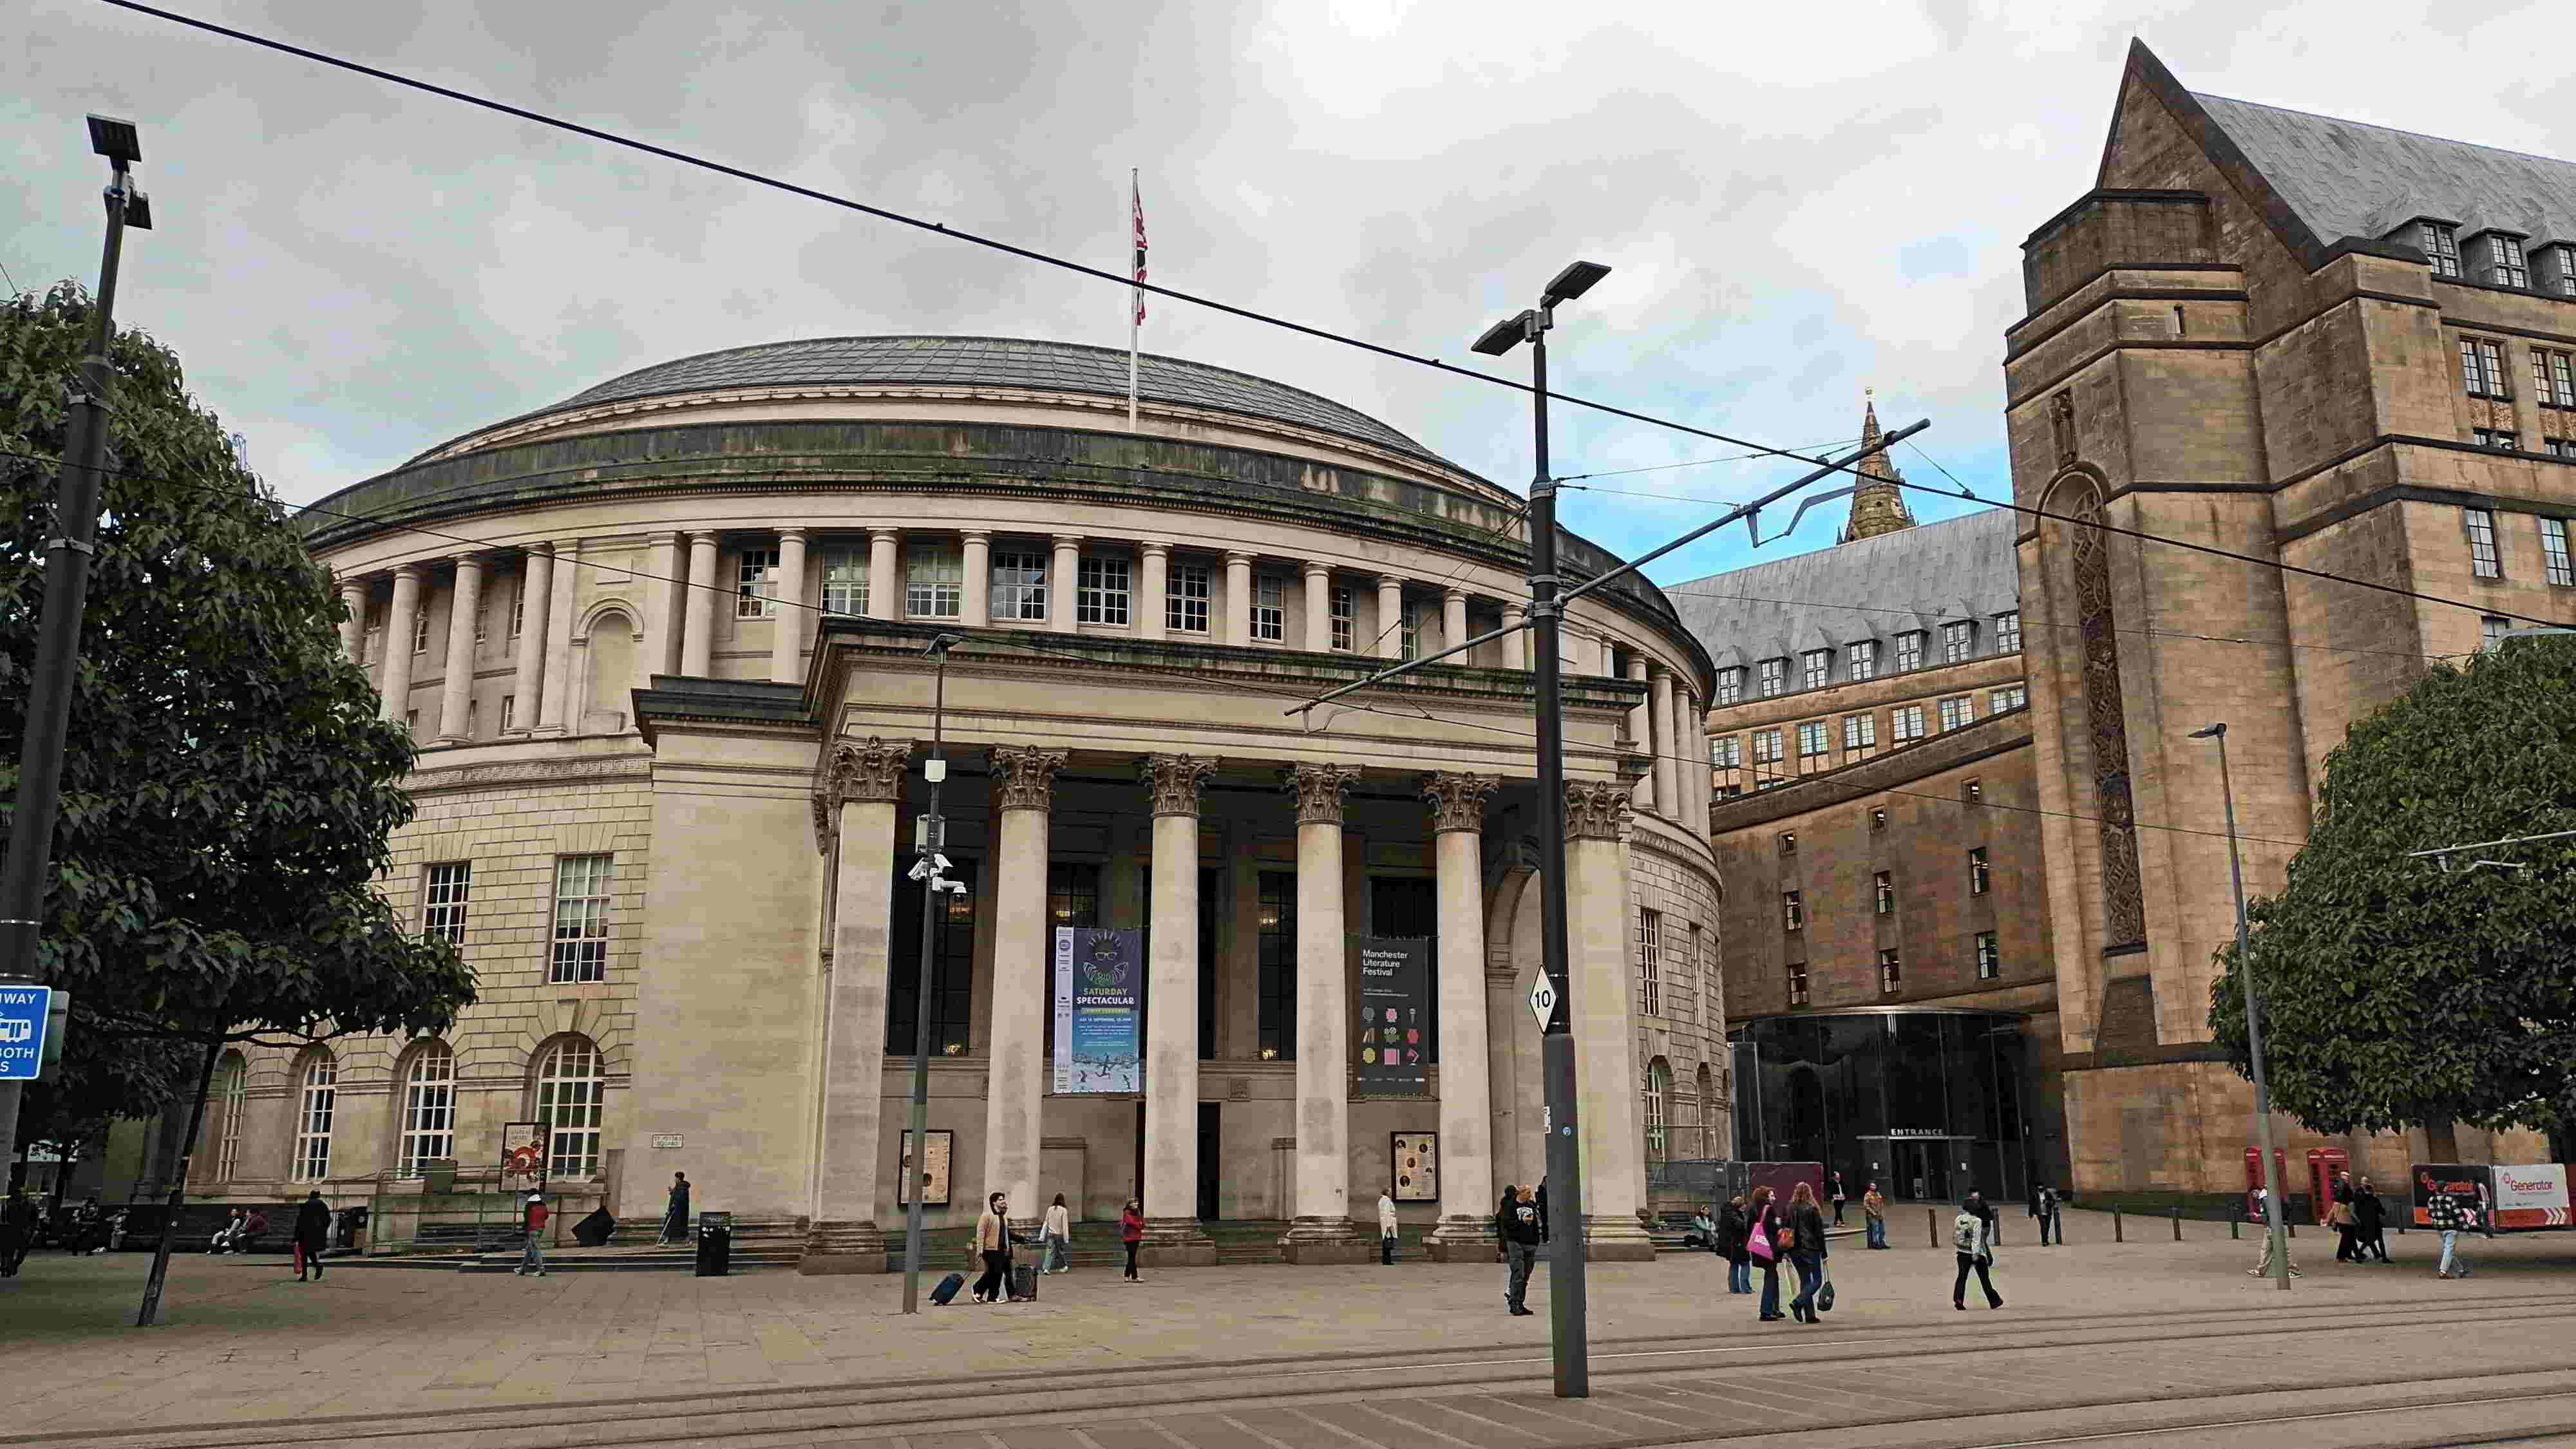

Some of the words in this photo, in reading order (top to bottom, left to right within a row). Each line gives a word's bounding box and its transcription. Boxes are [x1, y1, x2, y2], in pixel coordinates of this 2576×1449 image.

[1362, 949, 1408, 959] Manchester
[1362, 958, 1400, 967] Literature
[1362, 967, 1392, 976] Festival
[0, 993, 37, 1005] WAY
[1077, 996, 1135, 1005] SPECTACULAR
[1535, 990, 1551, 1009] 10
[0, 1047, 35, 1059] OTH
[2510, 1179, 2553, 1191] Generator
